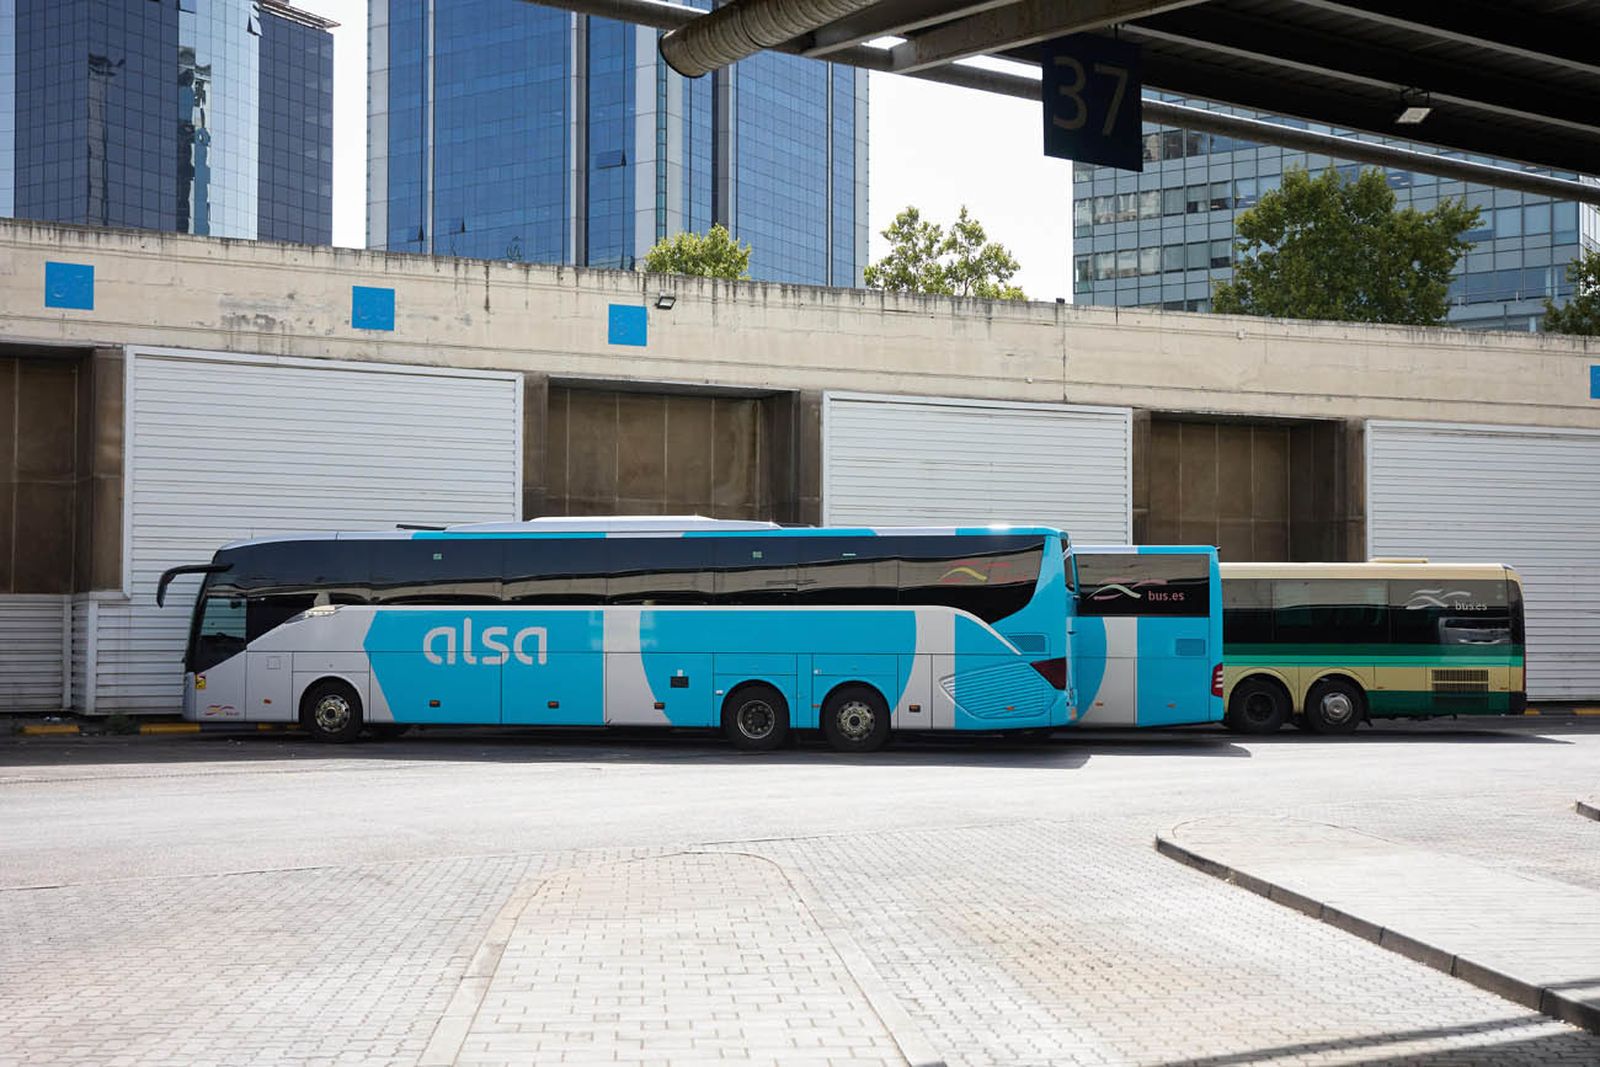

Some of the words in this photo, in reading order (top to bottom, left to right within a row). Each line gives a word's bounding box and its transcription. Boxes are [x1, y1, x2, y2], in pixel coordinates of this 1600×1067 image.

[1052, 56, 1128, 137] 37
[1148, 591, 1184, 602] bus.es
[1455, 600, 1488, 611] bus.es
[423, 618, 547, 665] alsa
